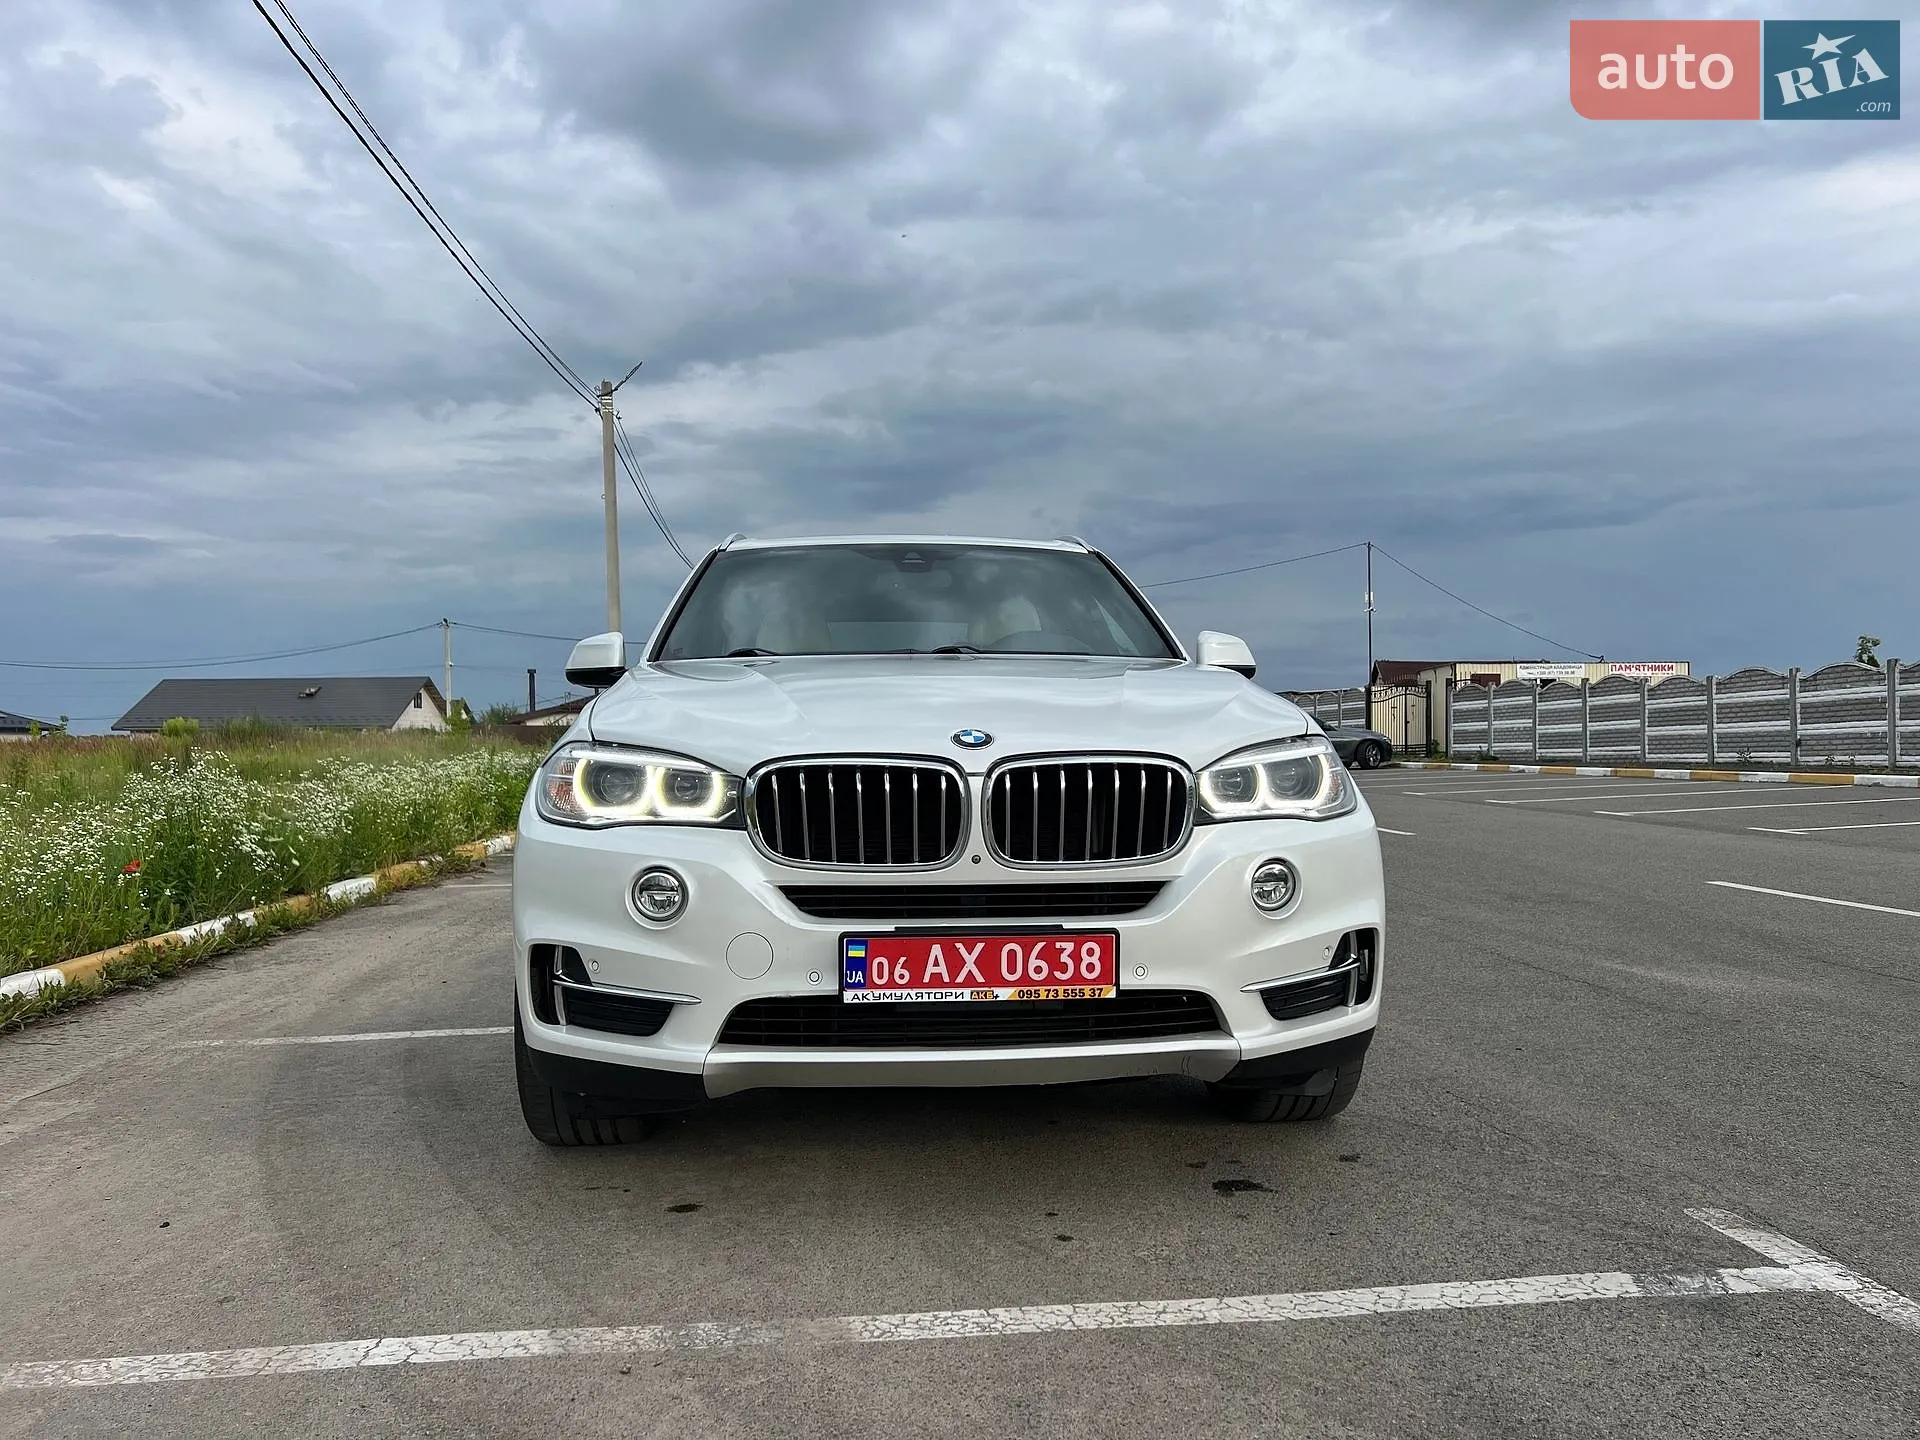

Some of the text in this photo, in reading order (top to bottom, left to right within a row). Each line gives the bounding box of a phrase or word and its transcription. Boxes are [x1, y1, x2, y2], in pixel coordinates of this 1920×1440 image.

[872, 941, 1101, 985] 06 AX 0638
[847, 971, 864, 984] UA
[851, 991, 964, 1002] АКУМУЛЯТОРИ
[1018, 989, 1040, 999] 095
[1045, 988, 1059, 999] 73
[1063, 988, 1085, 998] 555
[1089, 987, 1104, 997] 37
